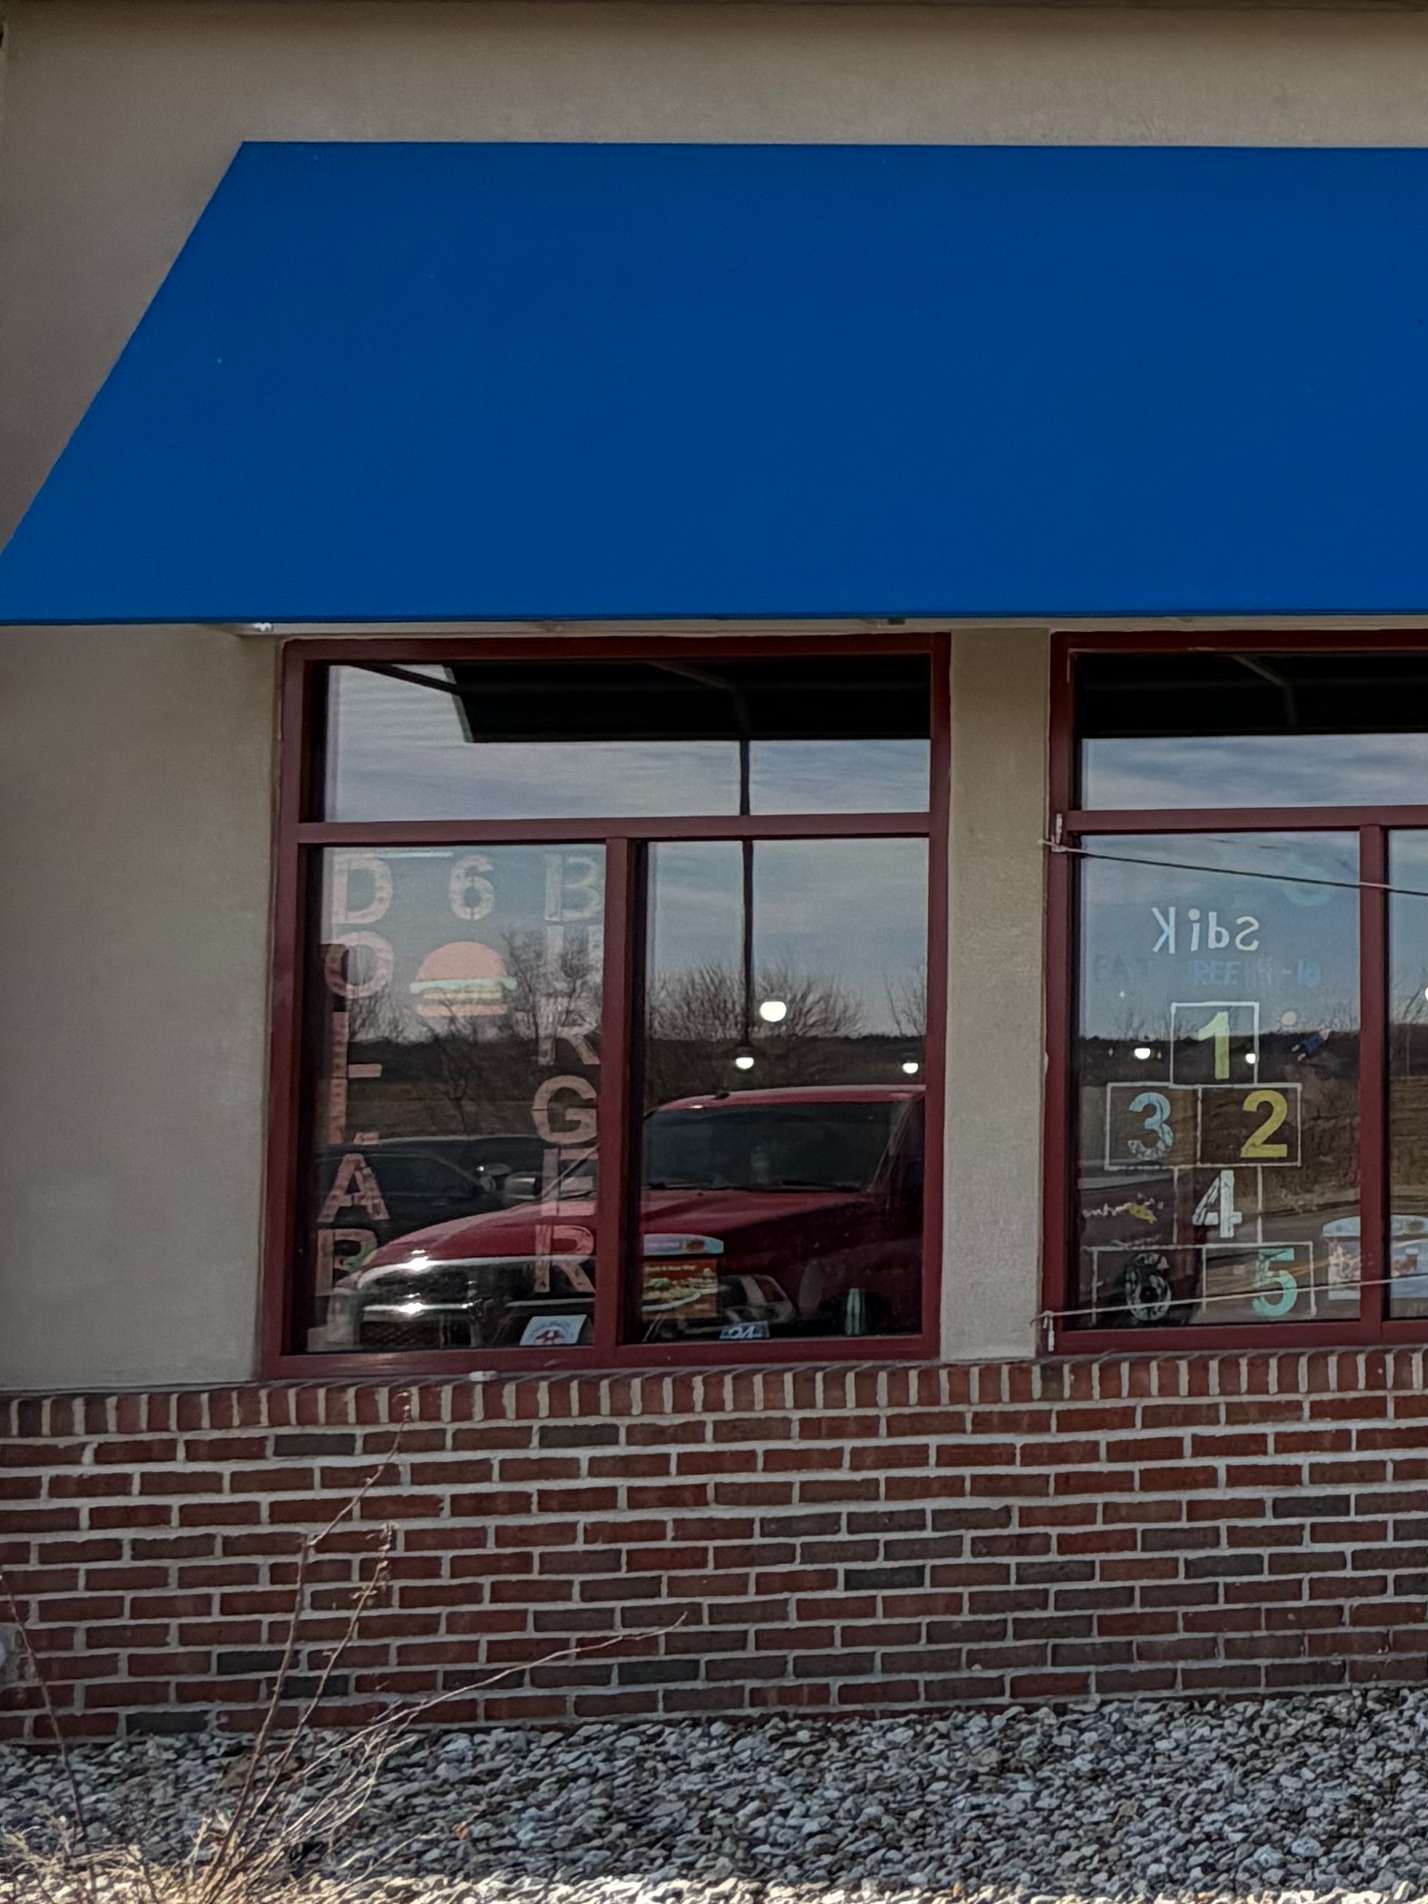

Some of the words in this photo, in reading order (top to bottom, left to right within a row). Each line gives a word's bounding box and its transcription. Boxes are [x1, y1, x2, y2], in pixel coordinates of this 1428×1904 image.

[451, 855, 496, 921] 6
[1199, 1011, 1230, 1079] 1
[1128, 1092, 1174, 1161] 3
[1240, 1090, 1288, 1158] 2
[1192, 1170, 1242, 1238] 4
[1253, 1248, 1299, 1318] 5
